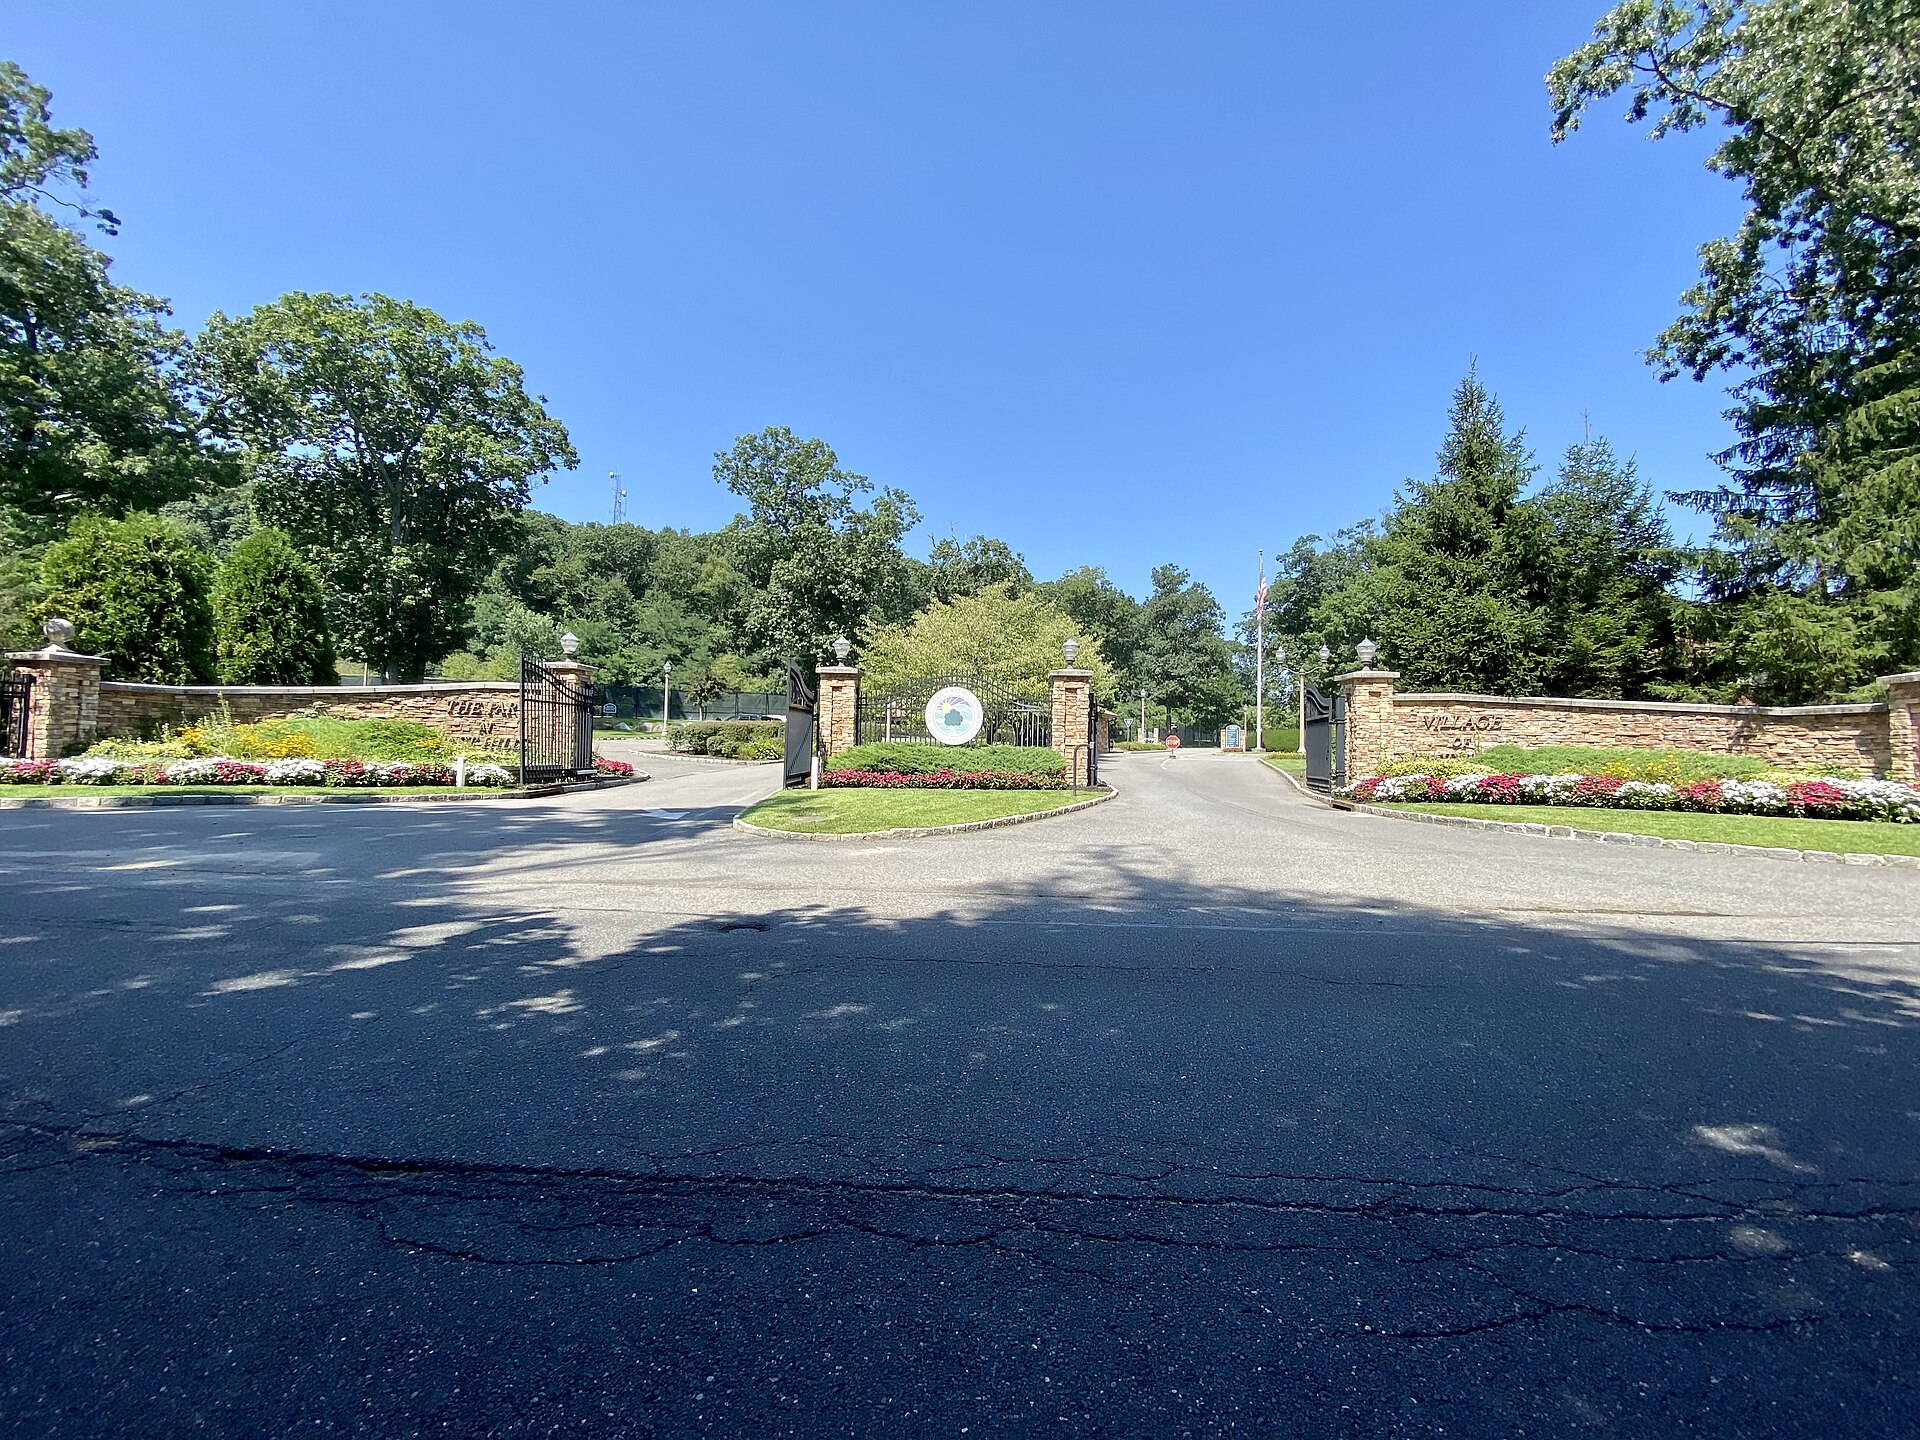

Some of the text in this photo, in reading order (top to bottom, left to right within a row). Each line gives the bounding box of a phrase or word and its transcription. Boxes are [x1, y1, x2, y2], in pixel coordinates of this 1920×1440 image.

[447, 701, 520, 718] THE PAR
[1423, 715, 1503, 731] VILLAGE
